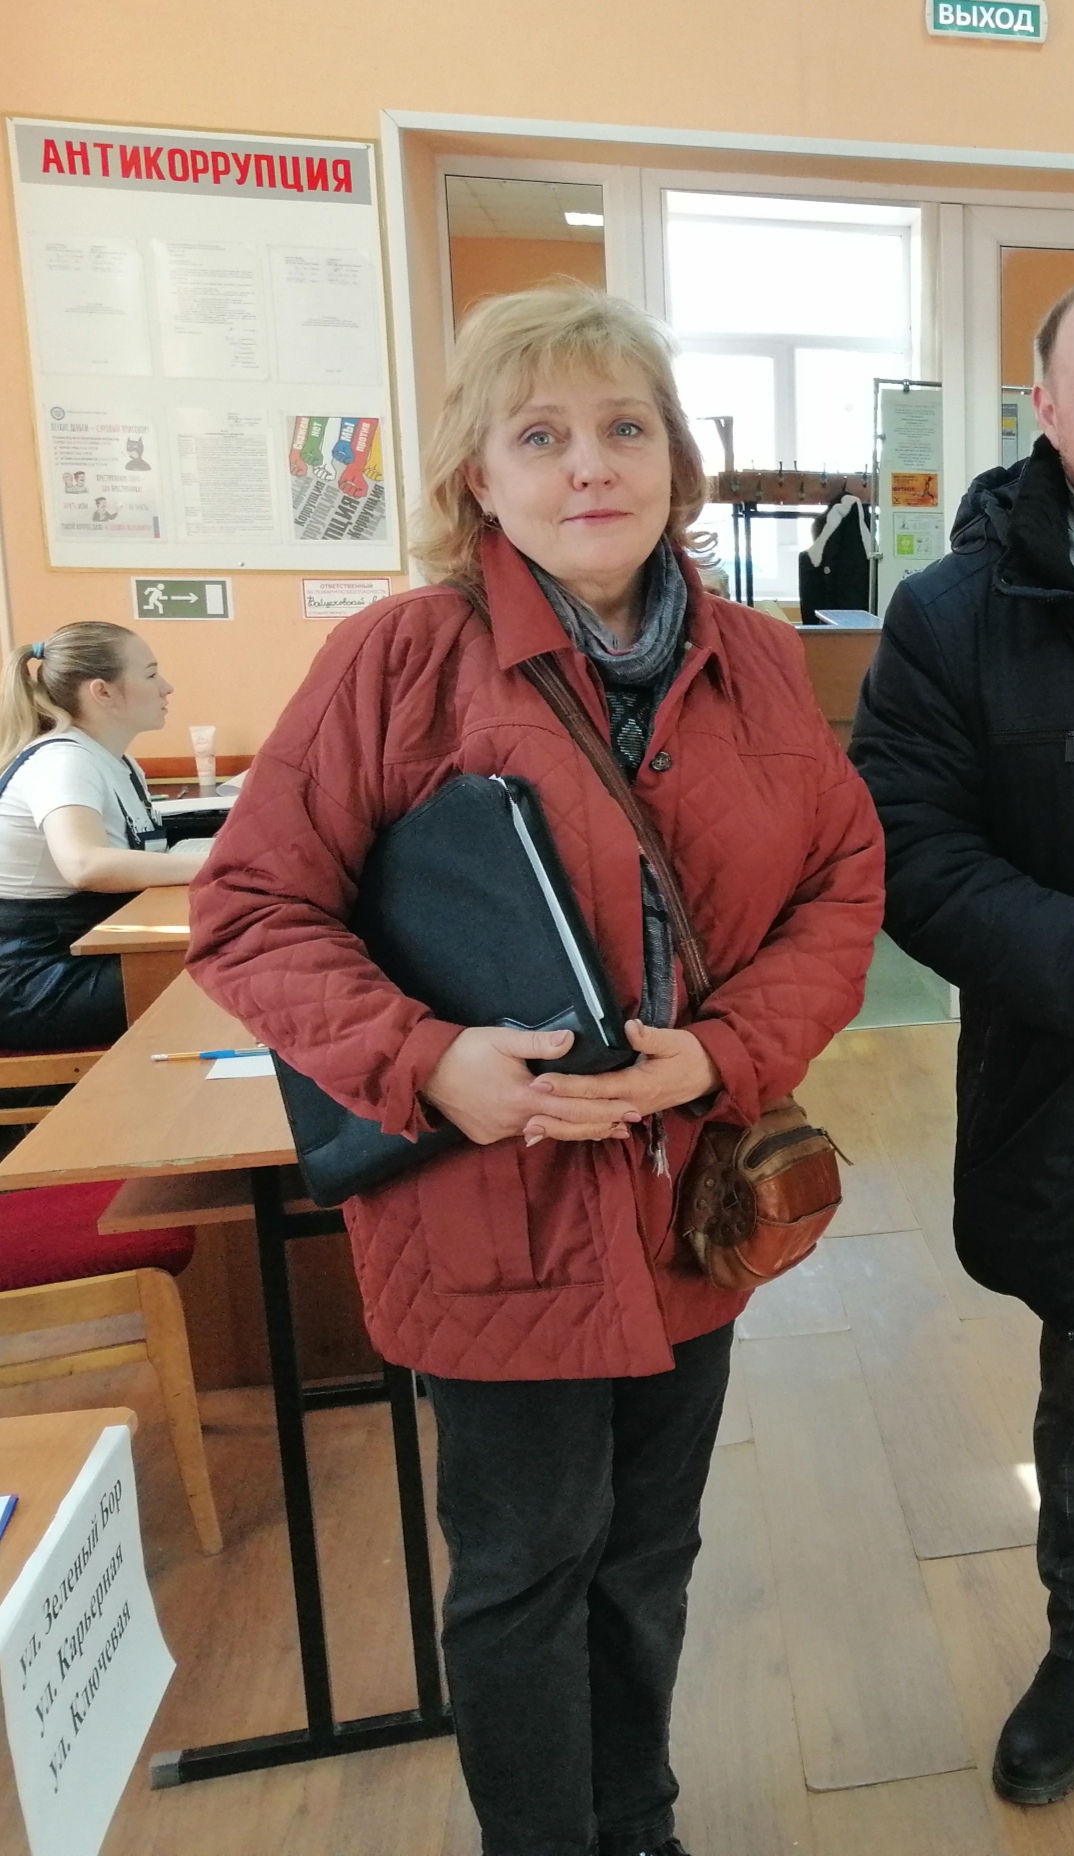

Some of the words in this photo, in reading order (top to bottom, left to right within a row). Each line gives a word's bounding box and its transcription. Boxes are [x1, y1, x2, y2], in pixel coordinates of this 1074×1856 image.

[939, 3, 1034, 32] ВЫХОД
[43, 139, 352, 193] АНТИКОРРУПЦИЯ
[19, 1632, 41, 1691] ул.
[44, 1514, 99, 1635] Зеленый
[100, 1479, 122, 1531] Бор
[34, 1681, 57, 1739] ул.
[58, 1542, 124, 1682] Карьерная
[49, 1737, 71, 1794] ул.
[70, 1600, 131, 1736] Ключевая
